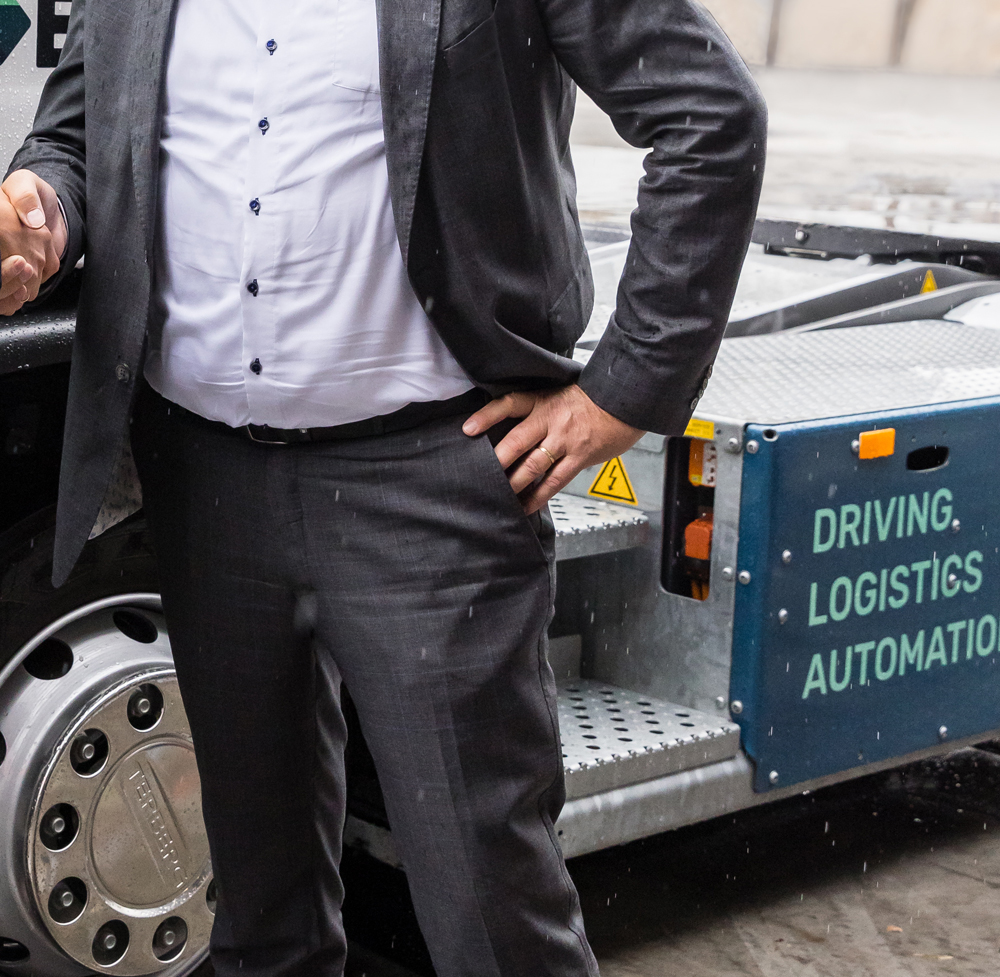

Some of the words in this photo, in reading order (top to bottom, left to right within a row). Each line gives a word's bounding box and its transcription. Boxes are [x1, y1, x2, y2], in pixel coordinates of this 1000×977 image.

[812, 487, 953, 554] DRIVING
[808, 550, 983, 626] LOGISTICS
[801, 614, 1000, 700] AUTOMATIO
[127, 769, 189, 889] TERBERG
